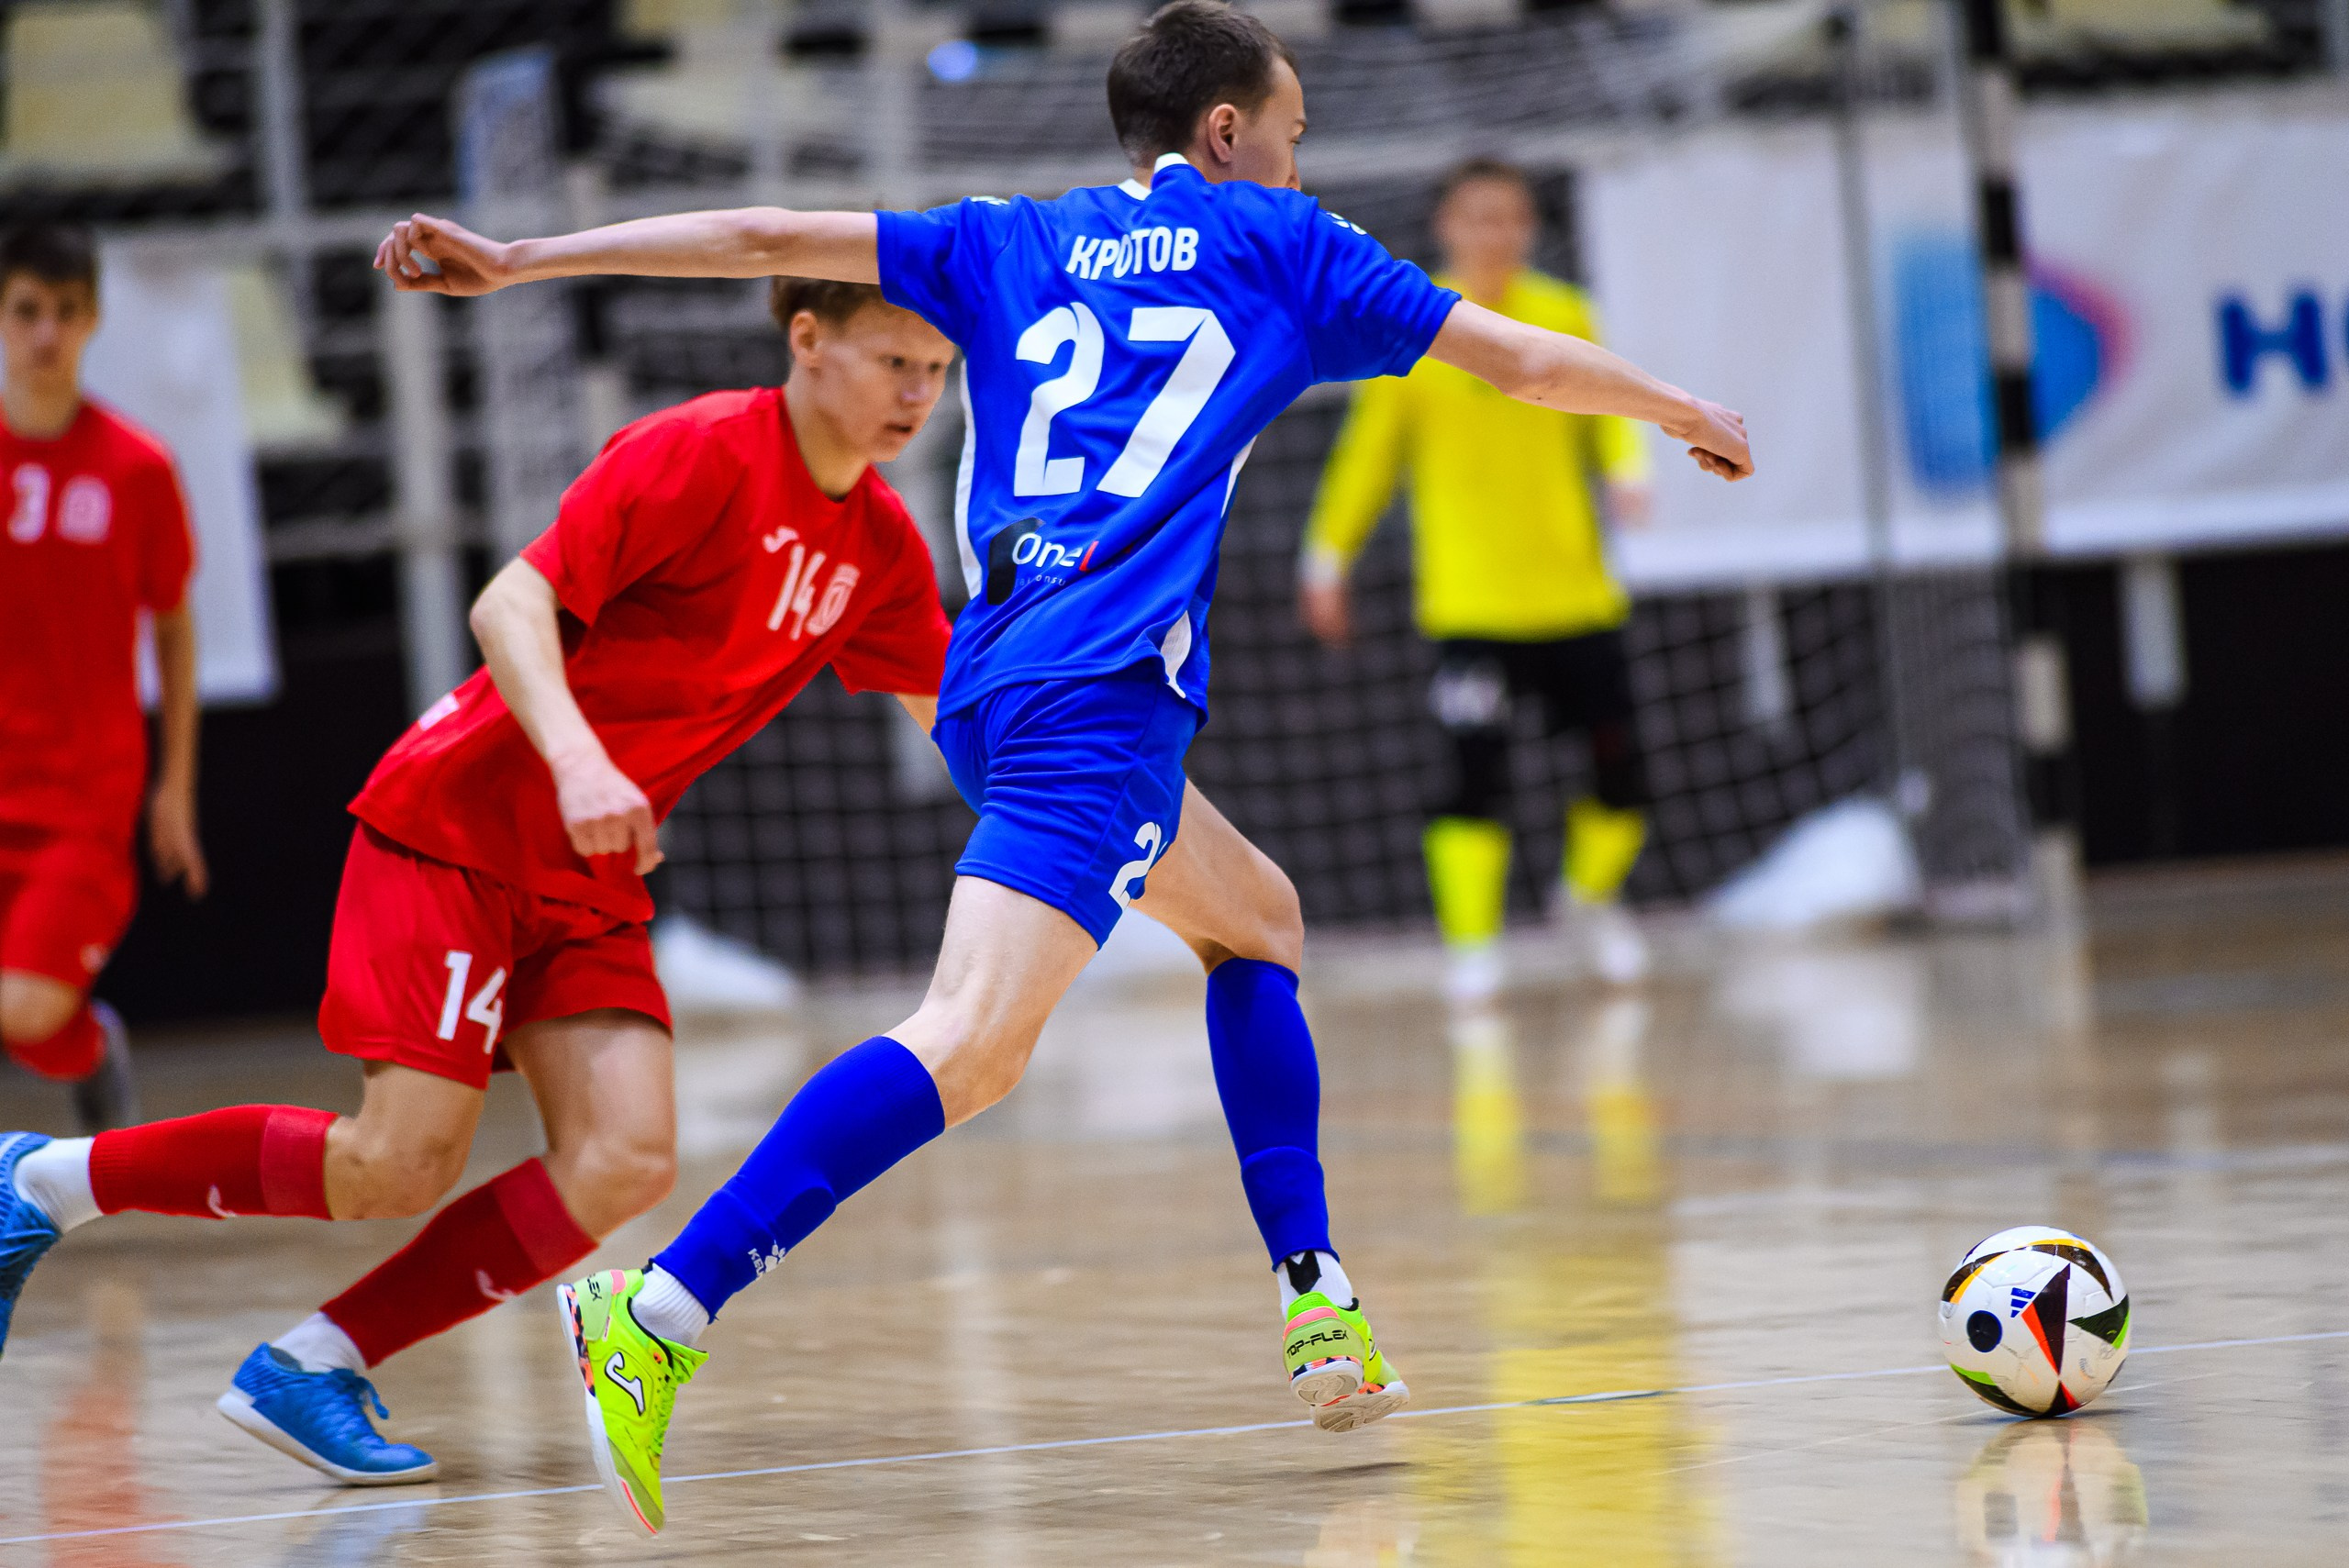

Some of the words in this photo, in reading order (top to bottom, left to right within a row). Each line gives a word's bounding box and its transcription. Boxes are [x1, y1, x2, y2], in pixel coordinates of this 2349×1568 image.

[1065, 226, 1199, 280] КРОТОВ
[1014, 302, 1236, 497] 27
[767, 543, 826, 640] 14
[1108, 821, 1168, 910] 2
[438, 950, 506, 1054] 14
[1286, 1329, 1349, 1358] TOP-FLEX
